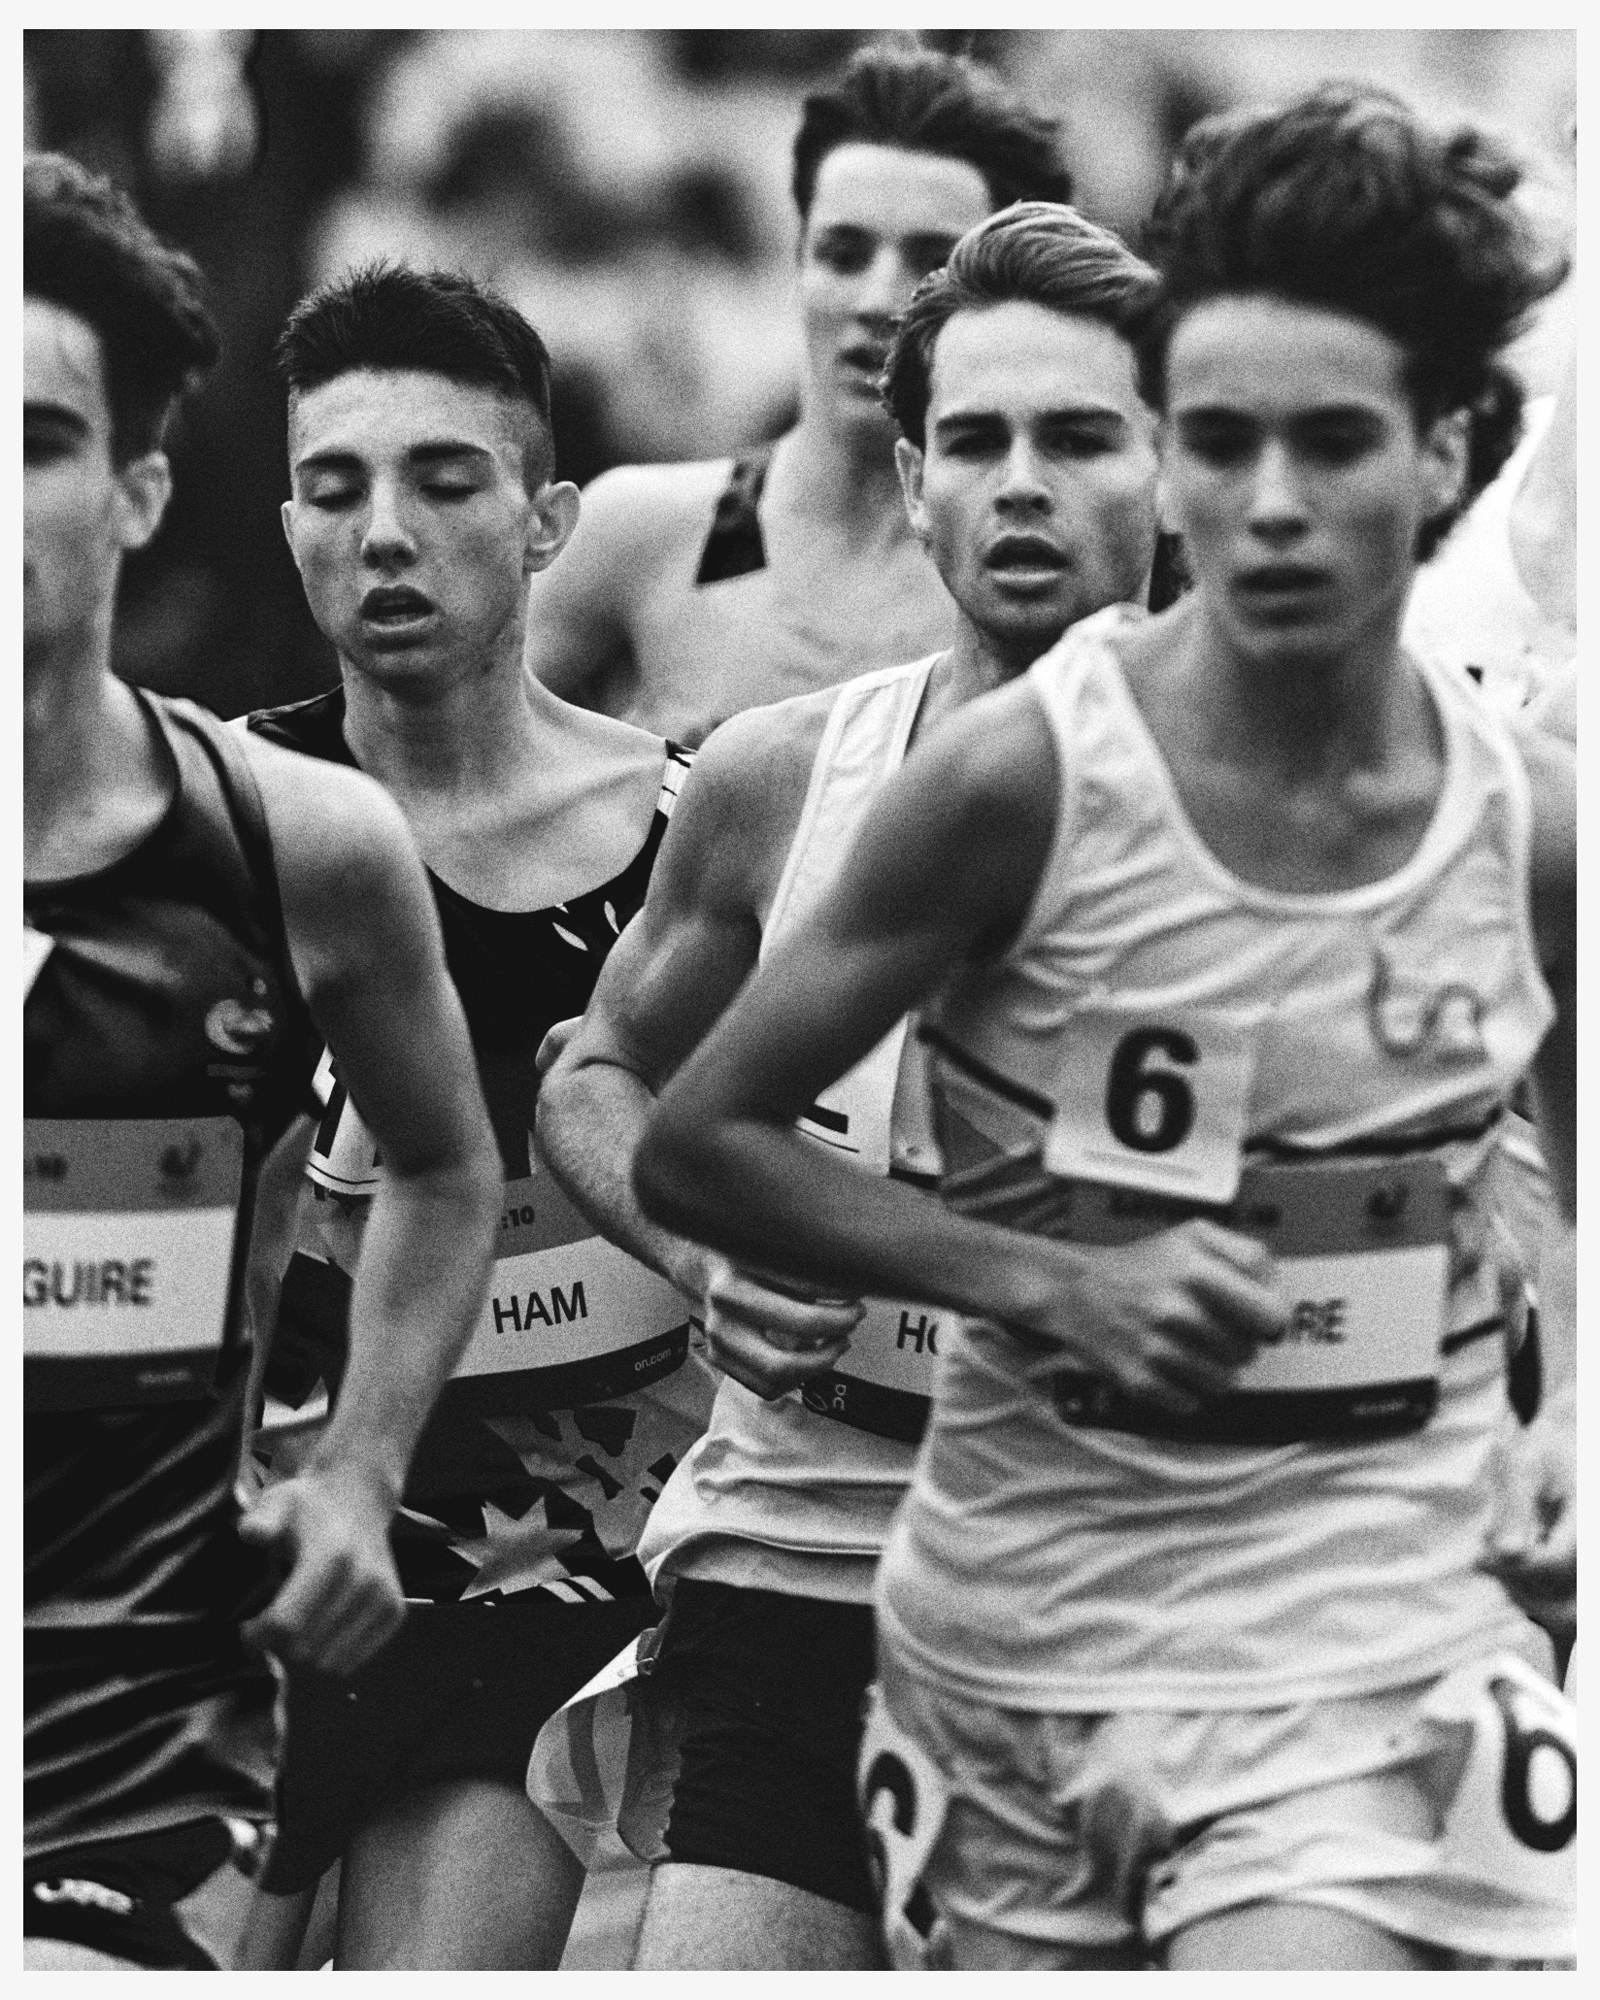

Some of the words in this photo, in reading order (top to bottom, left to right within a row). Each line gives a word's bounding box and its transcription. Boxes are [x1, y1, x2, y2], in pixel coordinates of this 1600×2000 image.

[1106, 1025, 1199, 1153] 6
[492, 1281, 588, 1334] HAM
[634, 1348, 672, 1371] on.com
